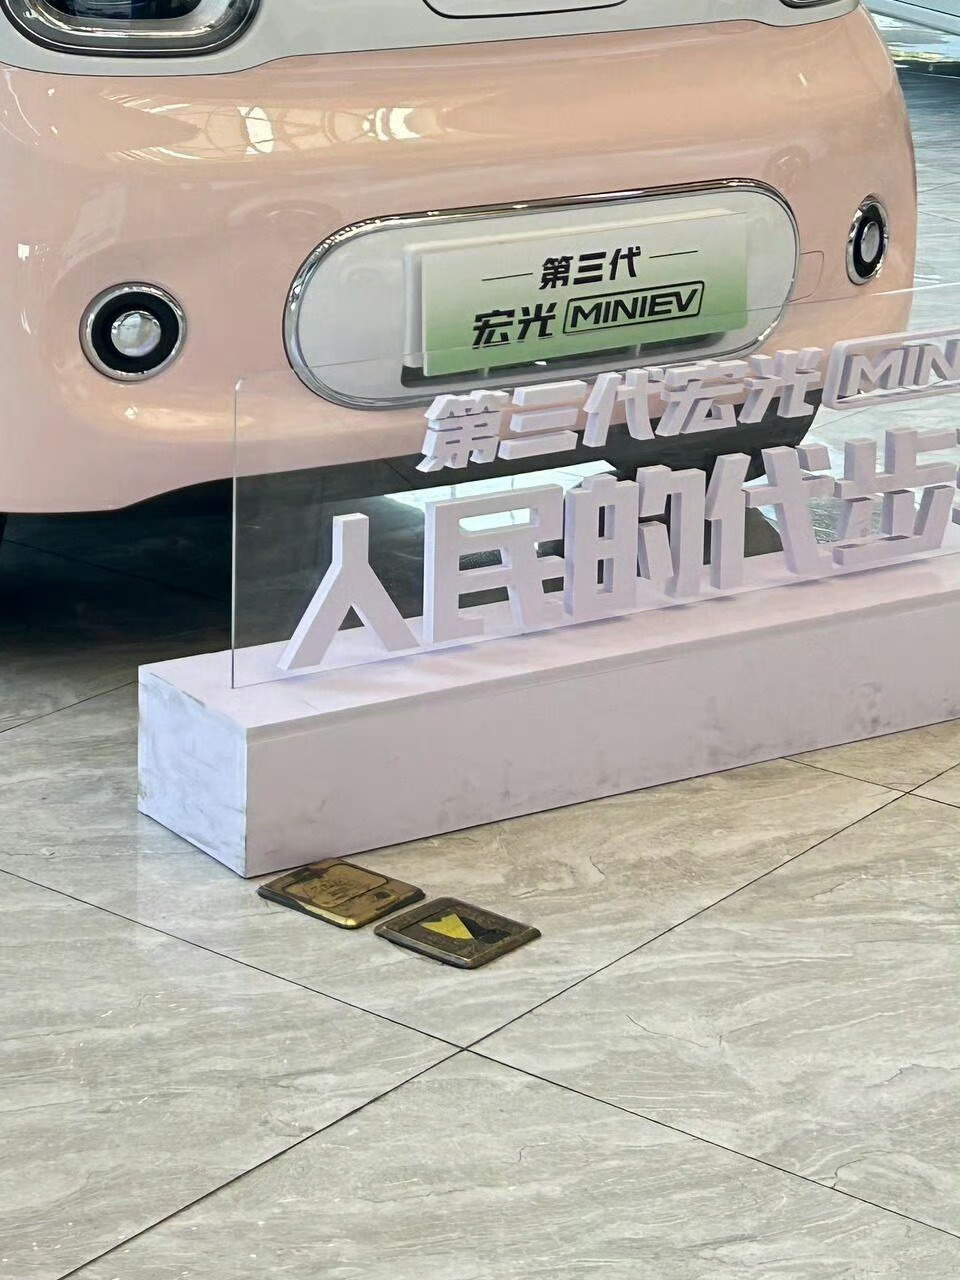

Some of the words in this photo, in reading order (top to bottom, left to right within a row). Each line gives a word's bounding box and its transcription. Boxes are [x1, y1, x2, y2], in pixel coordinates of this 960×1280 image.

[539, 246, 641, 289] 第三代
[472, 302, 558, 347] 宏光
[571, 288, 699, 328] MINIEV
[416, 347, 824, 472] 第三代宏光
[277, 427, 960, 670] 人民的代步
